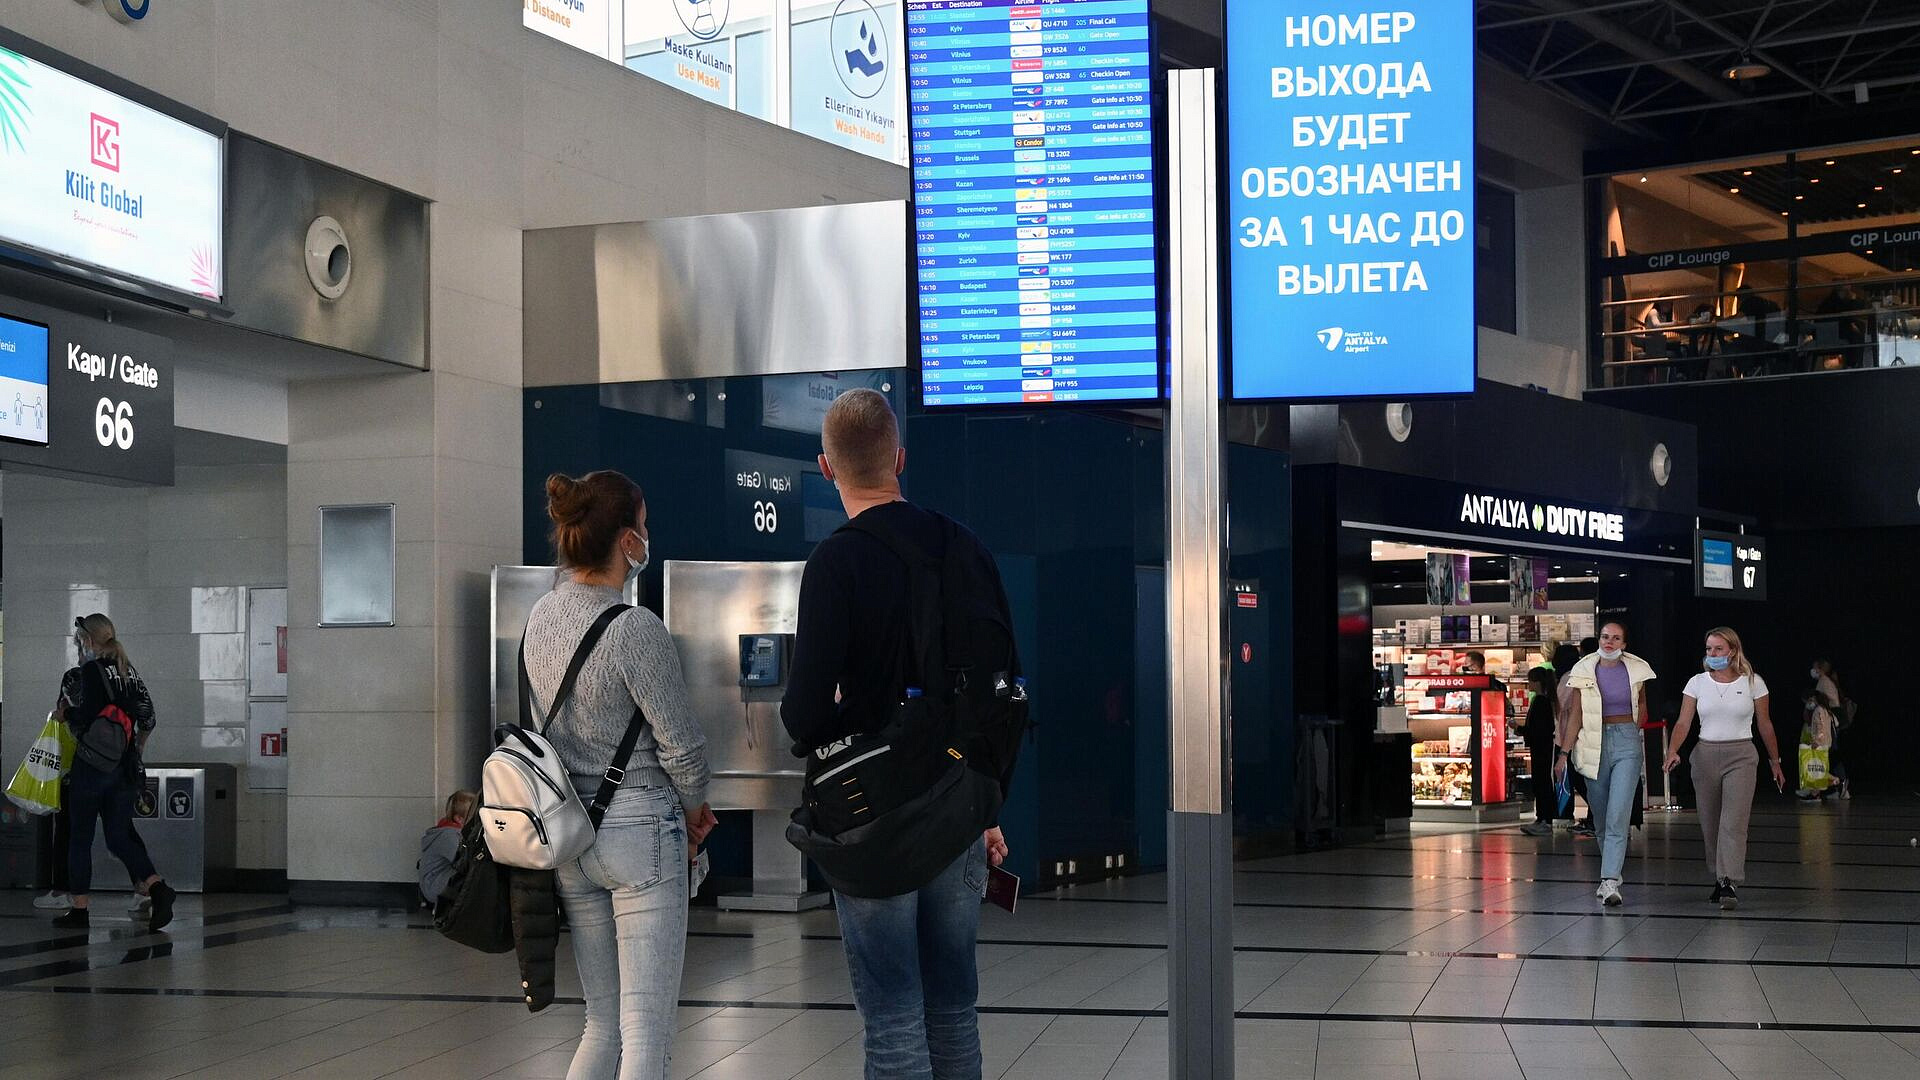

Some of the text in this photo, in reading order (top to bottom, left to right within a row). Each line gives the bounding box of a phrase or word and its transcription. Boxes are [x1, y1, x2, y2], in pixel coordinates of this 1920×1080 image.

[533, 0, 570, 28] Distance
[1285, 12, 1415, 48] НОМЕР
[664, 37, 733, 75] Maske Kullanın
[678, 63, 720, 90] Use Mask
[1115, 70, 1130, 78] Open
[1271, 61, 1432, 99] ВЫХОДА
[825, 97, 895, 128] Ellerinizi Yıkayın
[835, 118, 885, 144] Wash Hands
[954, 129, 980, 137] Stuttgart
[1292, 112, 1411, 151] БУДЕТ
[66, 169, 142, 219] Kilit Global
[1241, 160, 1461, 198] ОБОЗНАЧЕН
[956, 206, 997, 214] Sheremetyevo
[1239, 210, 1464, 248] ЗА 1 ЧАС ДО
[1850, 233, 1879, 247] CIP
[1648, 250, 1730, 268] CIP Lounge
[1278, 261, 1428, 295] ВЫЛЕТА
[969, 333, 1000, 341] Petersburg
[1345, 337, 1388, 345] ANTALYA
[67, 342, 158, 388] Kapı / Gate
[96, 397, 134, 450] 66
[1461, 494, 1624, 542] ANTALYA DUTY FREE
[1743, 566, 1755, 588] 67
